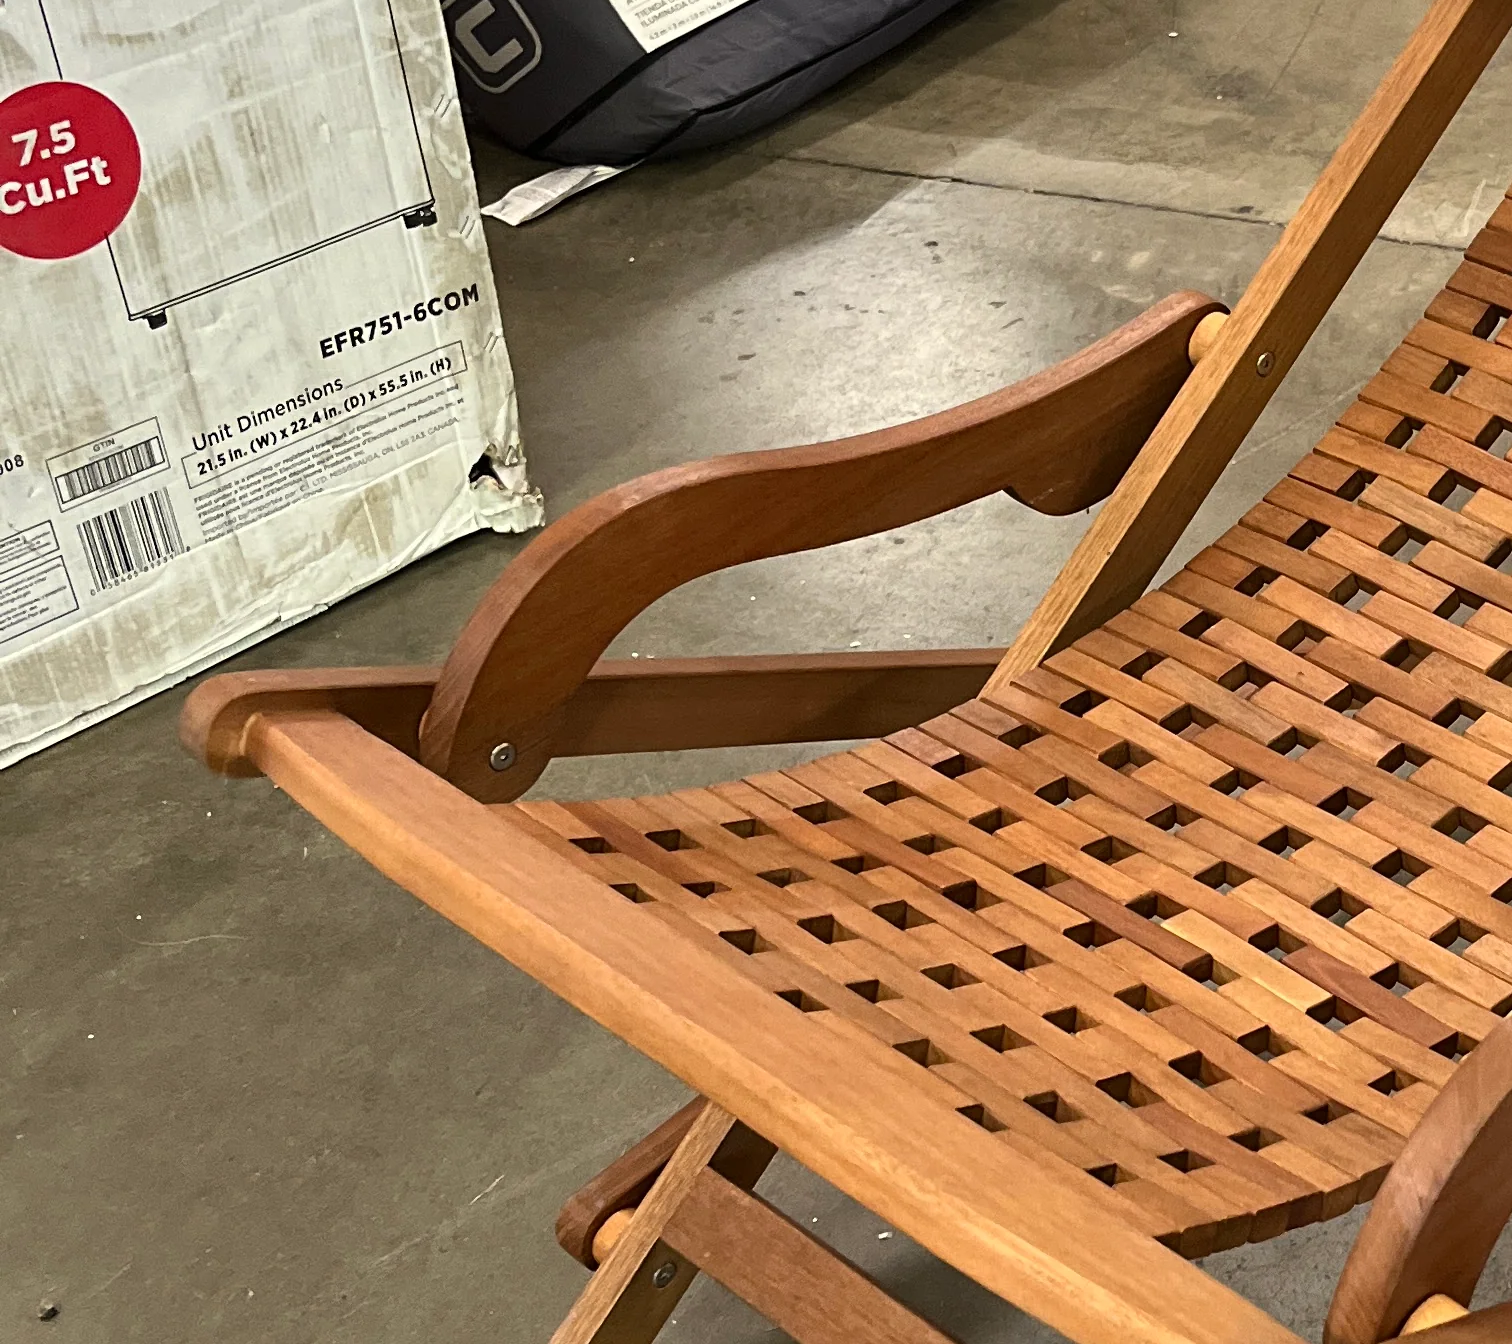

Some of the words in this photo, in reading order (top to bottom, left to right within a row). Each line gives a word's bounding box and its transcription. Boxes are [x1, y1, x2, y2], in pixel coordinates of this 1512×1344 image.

[12, 119, 77, 167] 7.5
[0, 154, 112, 218] Cu.Ft
[319, 284, 480, 359] EFR751-6COM
[192, 424, 234, 451] Unit
[236, 377, 344, 434] Dimensions
[197, 453, 226, 475] 21.5
[228, 445, 248, 461] in.
[250, 430, 278, 455] (W)
[280, 426, 289, 440] x
[290, 411, 322, 435] 22.4
[323, 405, 342, 421] in.
[343, 392, 367, 413] (D)
[369, 389, 377, 401] x
[378, 373, 409, 397] 55.5
[410, 366, 428, 384] in.
[430, 356, 452, 377] (H)
